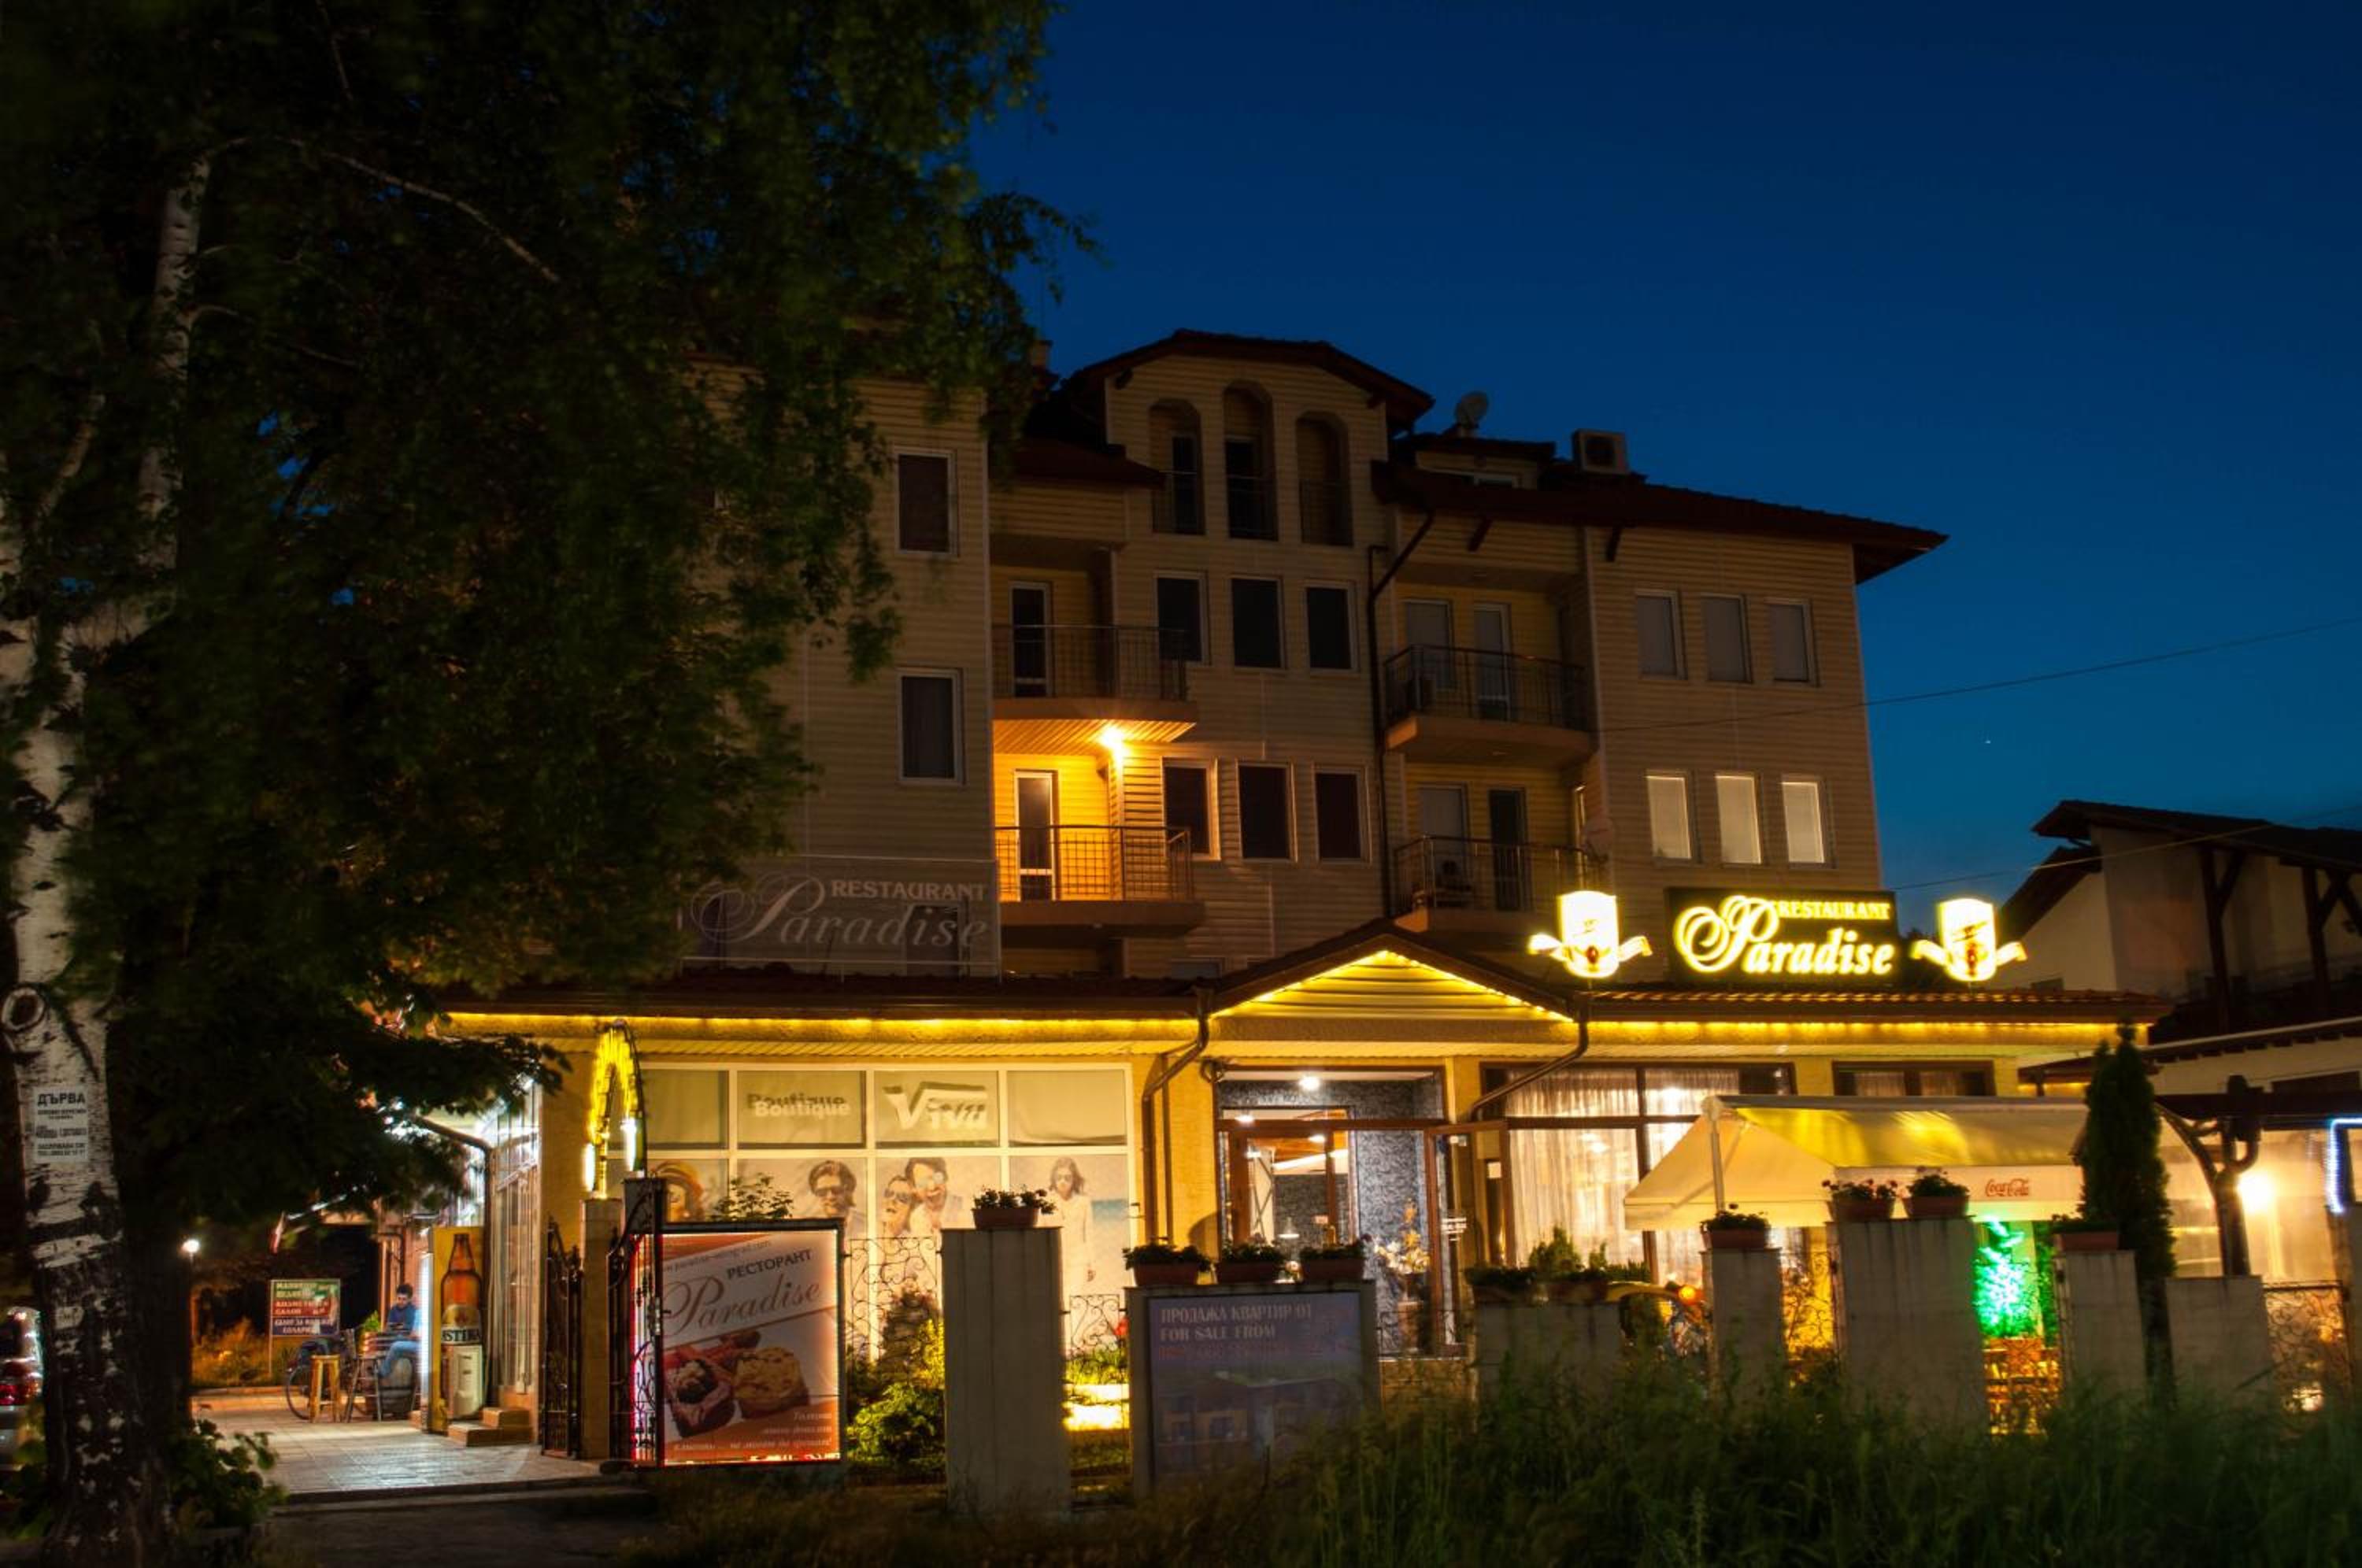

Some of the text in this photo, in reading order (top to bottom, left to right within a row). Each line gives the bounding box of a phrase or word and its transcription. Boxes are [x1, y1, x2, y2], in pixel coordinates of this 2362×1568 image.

[831, 880, 986, 901] RESTAURANT
[690, 871, 986, 946] Paradise
[1776, 901, 1890, 919] RESTAURANT
[1673, 896, 1894, 974] Paradise
[38, 1093, 86, 1107] ДЪРВА
[753, 1096, 851, 1119] Boutique
[727, 1248, 812, 1280] РЕСТОРАНТ
[663, 1273, 820, 1337] Paradise
[1161, 1307, 1227, 1323] ПРОДАЖА
[1161, 1326, 1190, 1341] FOR
[1194, 1325, 1227, 1340] SALE
